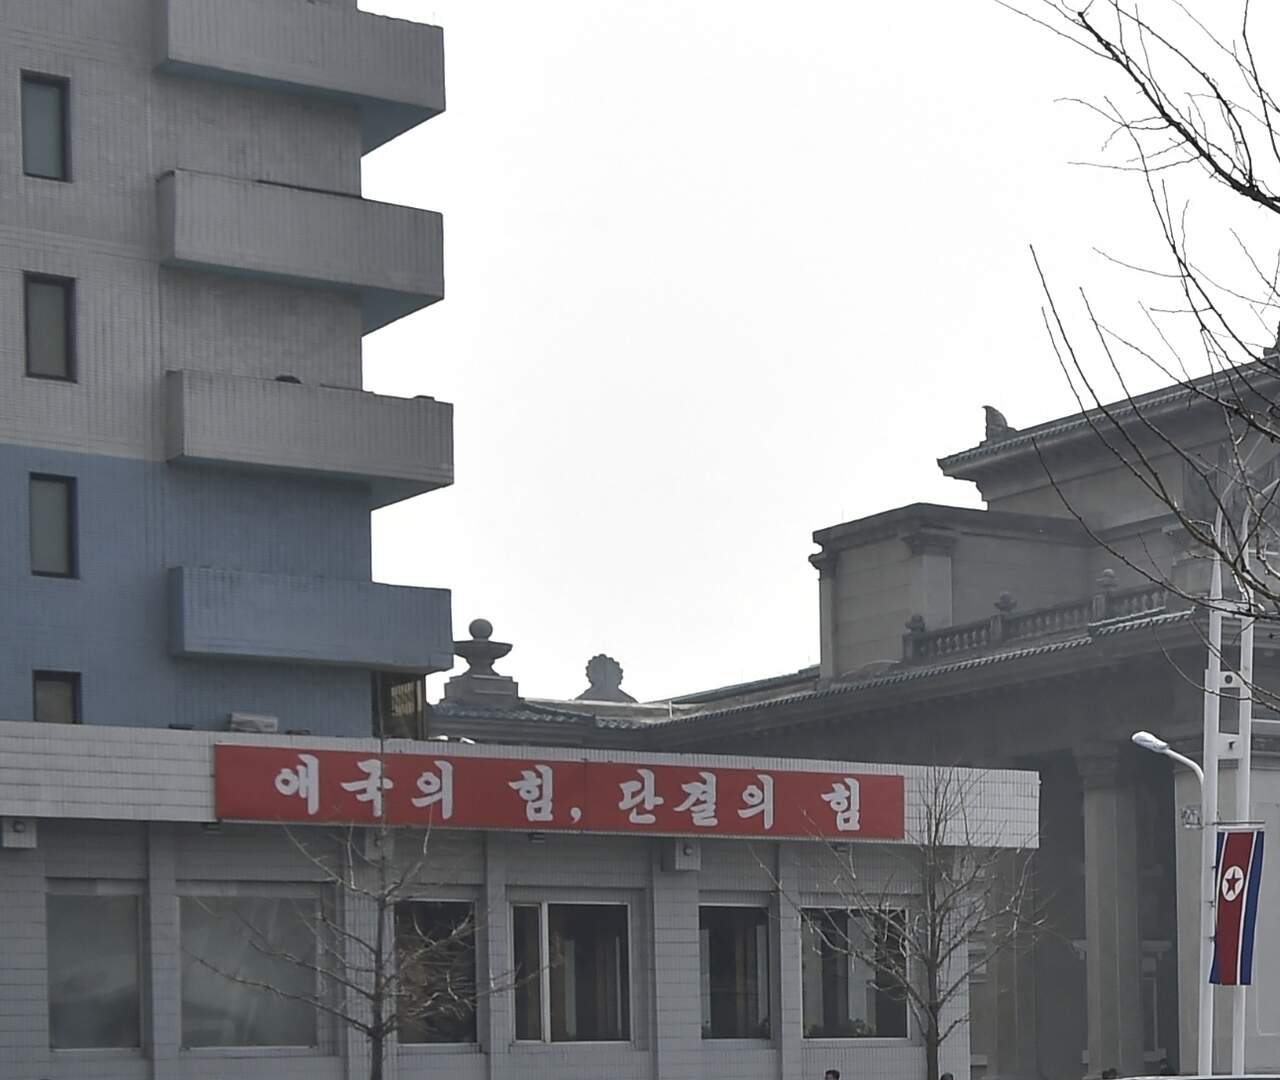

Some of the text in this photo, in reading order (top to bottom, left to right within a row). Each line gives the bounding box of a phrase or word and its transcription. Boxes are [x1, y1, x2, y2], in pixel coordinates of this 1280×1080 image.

[274, 754, 860, 832] 애국의 힘, 단결의 힘
